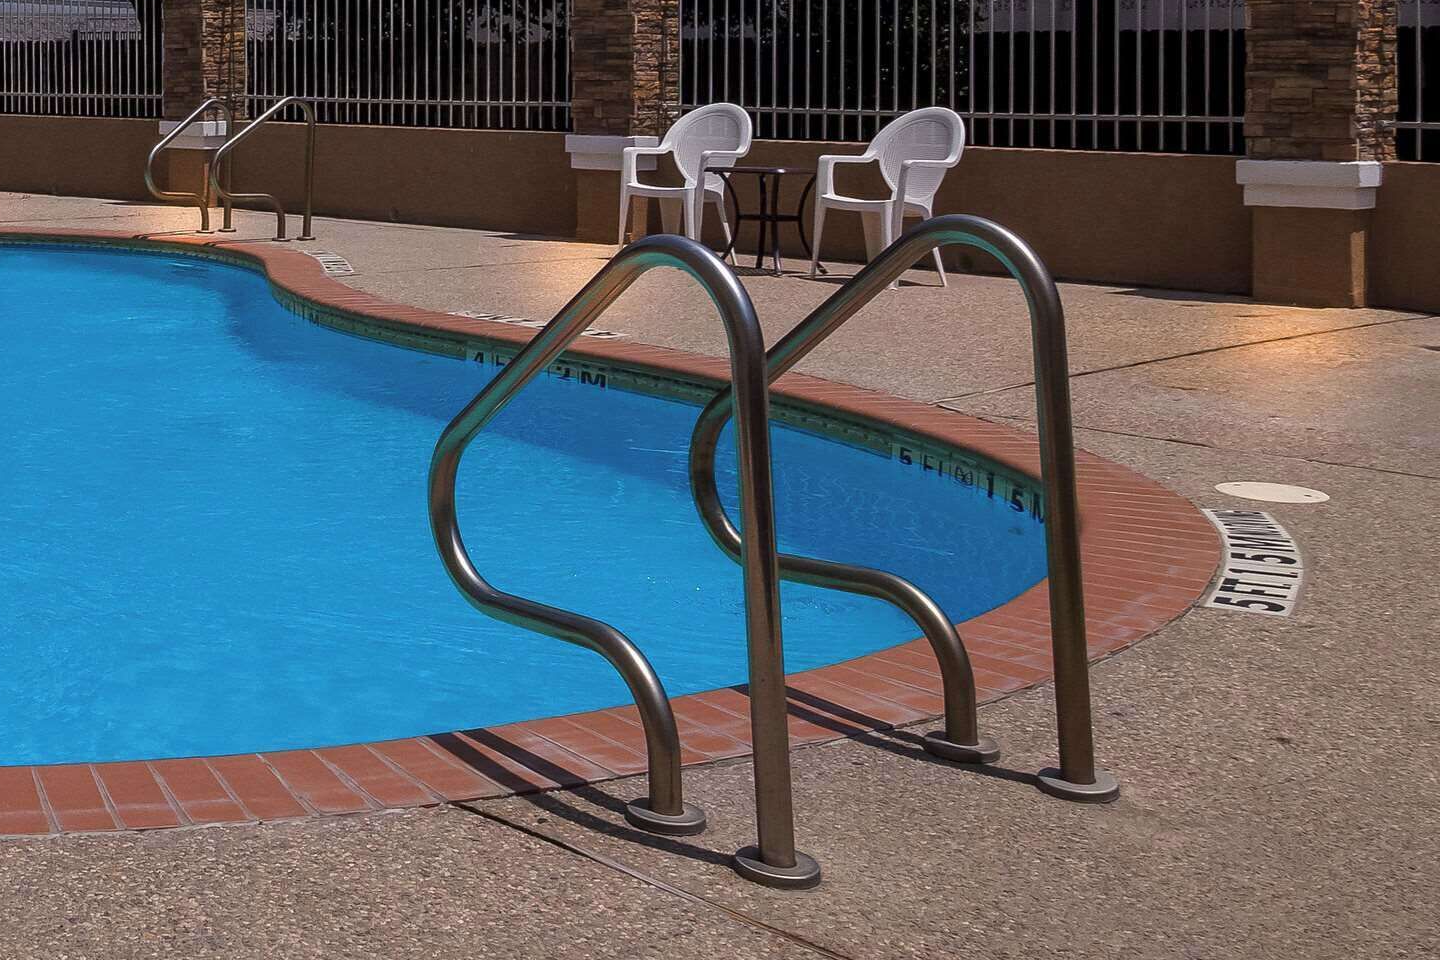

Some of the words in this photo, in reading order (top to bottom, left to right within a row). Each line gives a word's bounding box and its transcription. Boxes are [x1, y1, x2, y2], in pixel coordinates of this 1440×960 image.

[581, 371, 607, 389] M
[900, 447, 912, 465] 5
[1227, 535, 1295, 552] M
[1213, 596, 1286, 612] 5
